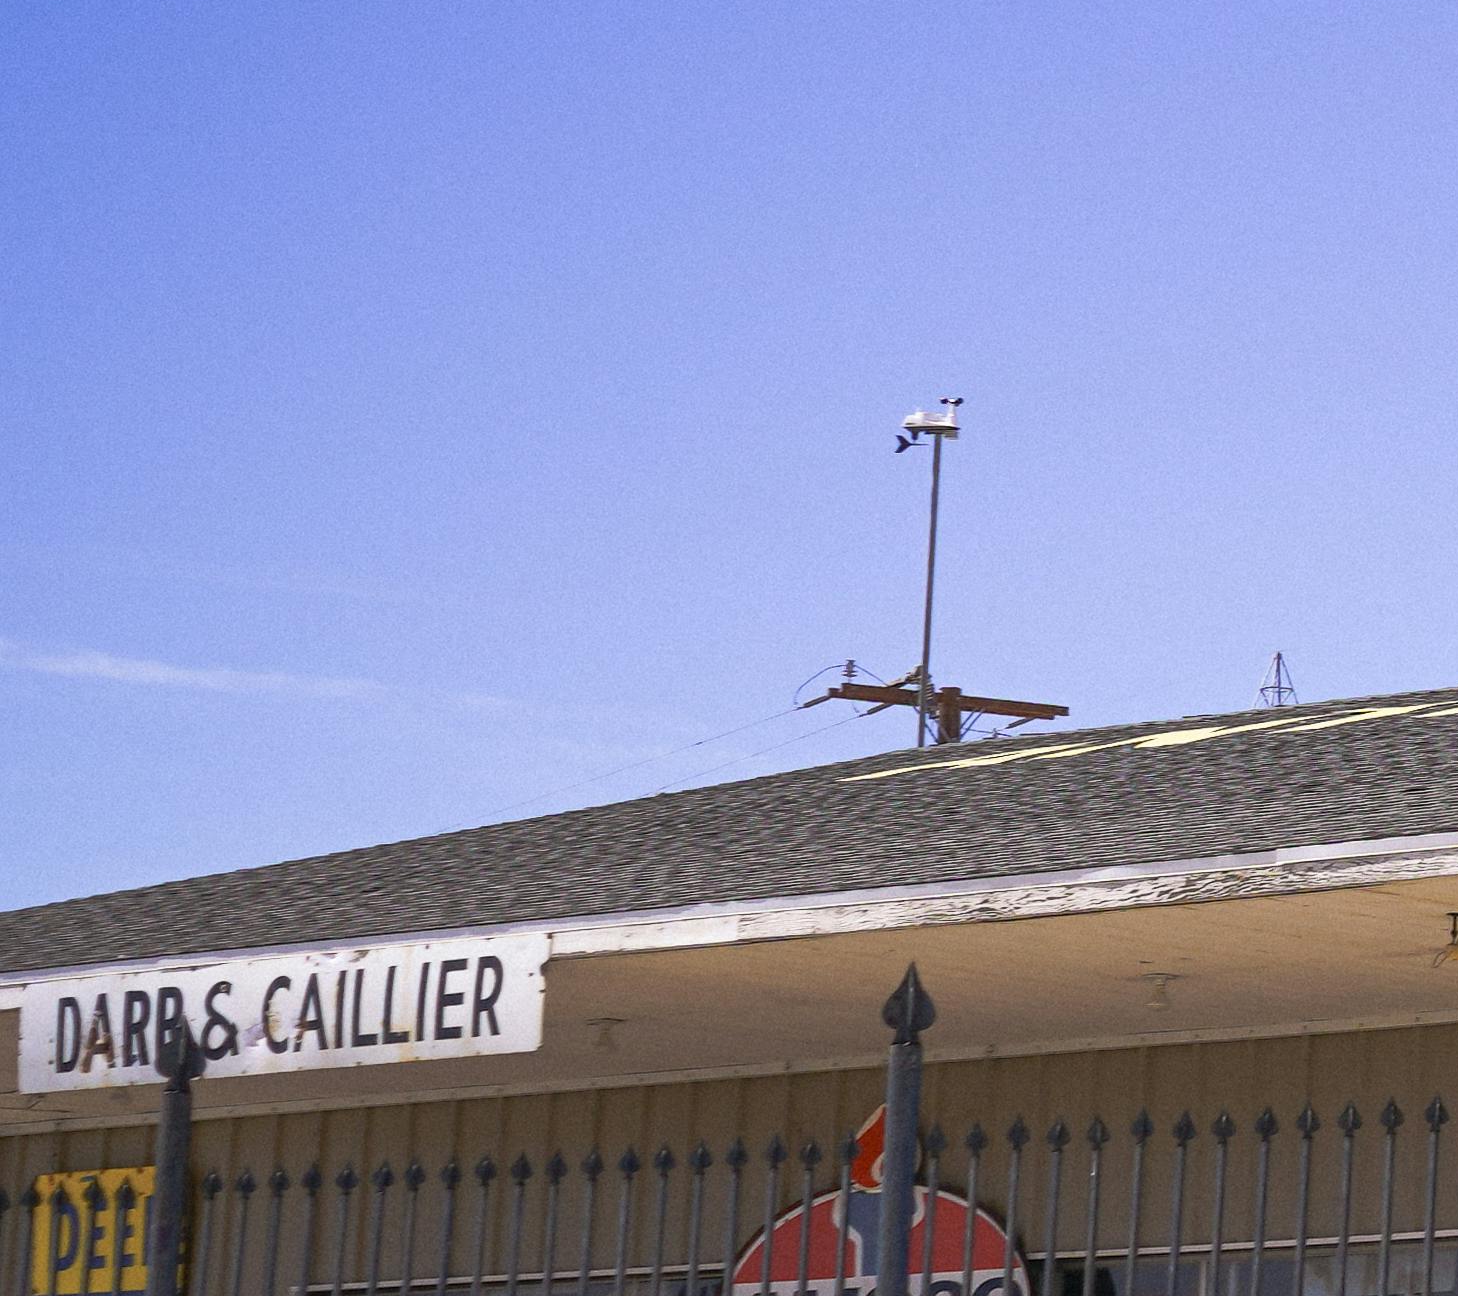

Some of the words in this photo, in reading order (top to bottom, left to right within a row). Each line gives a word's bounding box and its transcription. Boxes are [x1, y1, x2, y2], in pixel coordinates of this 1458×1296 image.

[202, 980, 239, 1061] &
[263, 955, 505, 1055] CAILLIER
[54, 1195, 155, 1272] DEE
